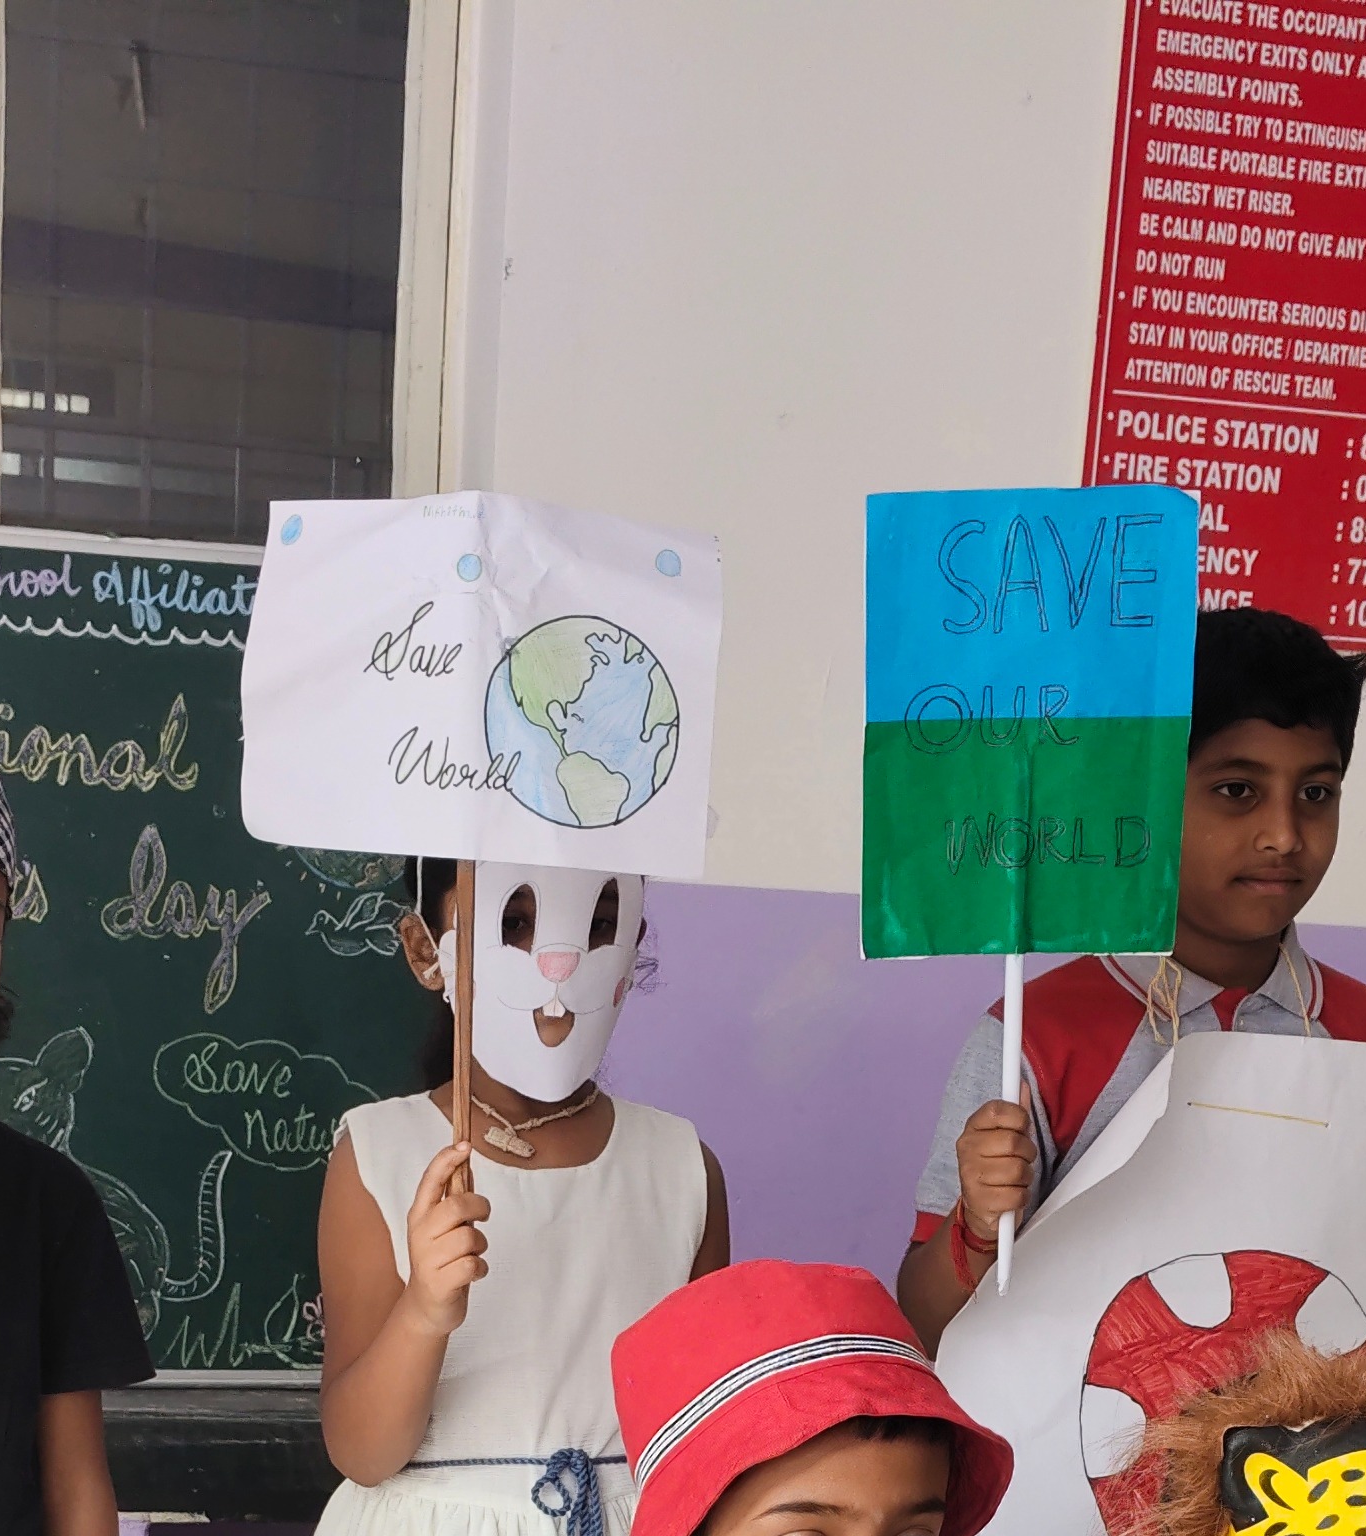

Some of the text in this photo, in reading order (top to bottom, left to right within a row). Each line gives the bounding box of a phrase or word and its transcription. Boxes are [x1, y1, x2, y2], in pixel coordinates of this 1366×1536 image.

[1159, 0, 1243, 25] EVACUATE
[1247, 3, 1279, 30] THE
[1156, 28, 1257, 63] EMERGENCY
[1260, 43, 1307, 71] EXITS
[1311, 50, 1355, 77] ONLY
[1152, 66, 1303, 108] ASSEMBLY POINTS.
[1149, 101, 1164, 126] IF
[1165, 104, 1233, 135] POSSIBLE
[1234, 113, 1262, 139] TRY
[1264, 117, 1283, 142] TO
[1146, 139, 1218, 171] SUITABLE
[1220, 149, 1297, 181] PORTABLE
[1298, 158, 1332, 185] FIRE
[1142, 176, 1296, 217] NEAREST WET RISER.
[1139, 212, 1160, 237] BE
[1162, 215, 1204, 242] CALM
[1205, 221, 1237, 246] AND
[1240, 224, 1262, 250] DO
[1264, 227, 1296, 253] NOT
[1298, 231, 1334, 257] GIVE
[1135, 249, 1226, 281] DO NOT RUN
[1132, 285, 1148, 309] IF
[1151, 287, 1183, 313] YOU
[1186, 291, 1278, 324] ENCOUNTER
[1281, 301, 1347, 330] SERIOUS
[1128, 321, 1166, 348] STAY
[1168, 326, 1185, 349] IN
[1189, 328, 1229, 354] YOUR
[1232, 333, 1283, 360] OFFICE
[1125, 357, 1337, 401] ATTENTION OF RESCUE TEAM.
[1116, 409, 1208, 445] POLICE
[1213, 418, 1320, 456] STATION
[1112, 451, 1170, 484] FIRE
[1175, 457, 1282, 495] STATION
[937, 513, 1163, 635] SAVE
[93, 563, 259, 632] Affiliat
[363, 601, 462, 681] Save
[905, 682, 1080, 754] OUR
[387, 726, 523, 793] World
[944, 813, 1151, 876] WORLD
[102, 822, 273, 1014] day
[183, 1042, 292, 1098] Save
